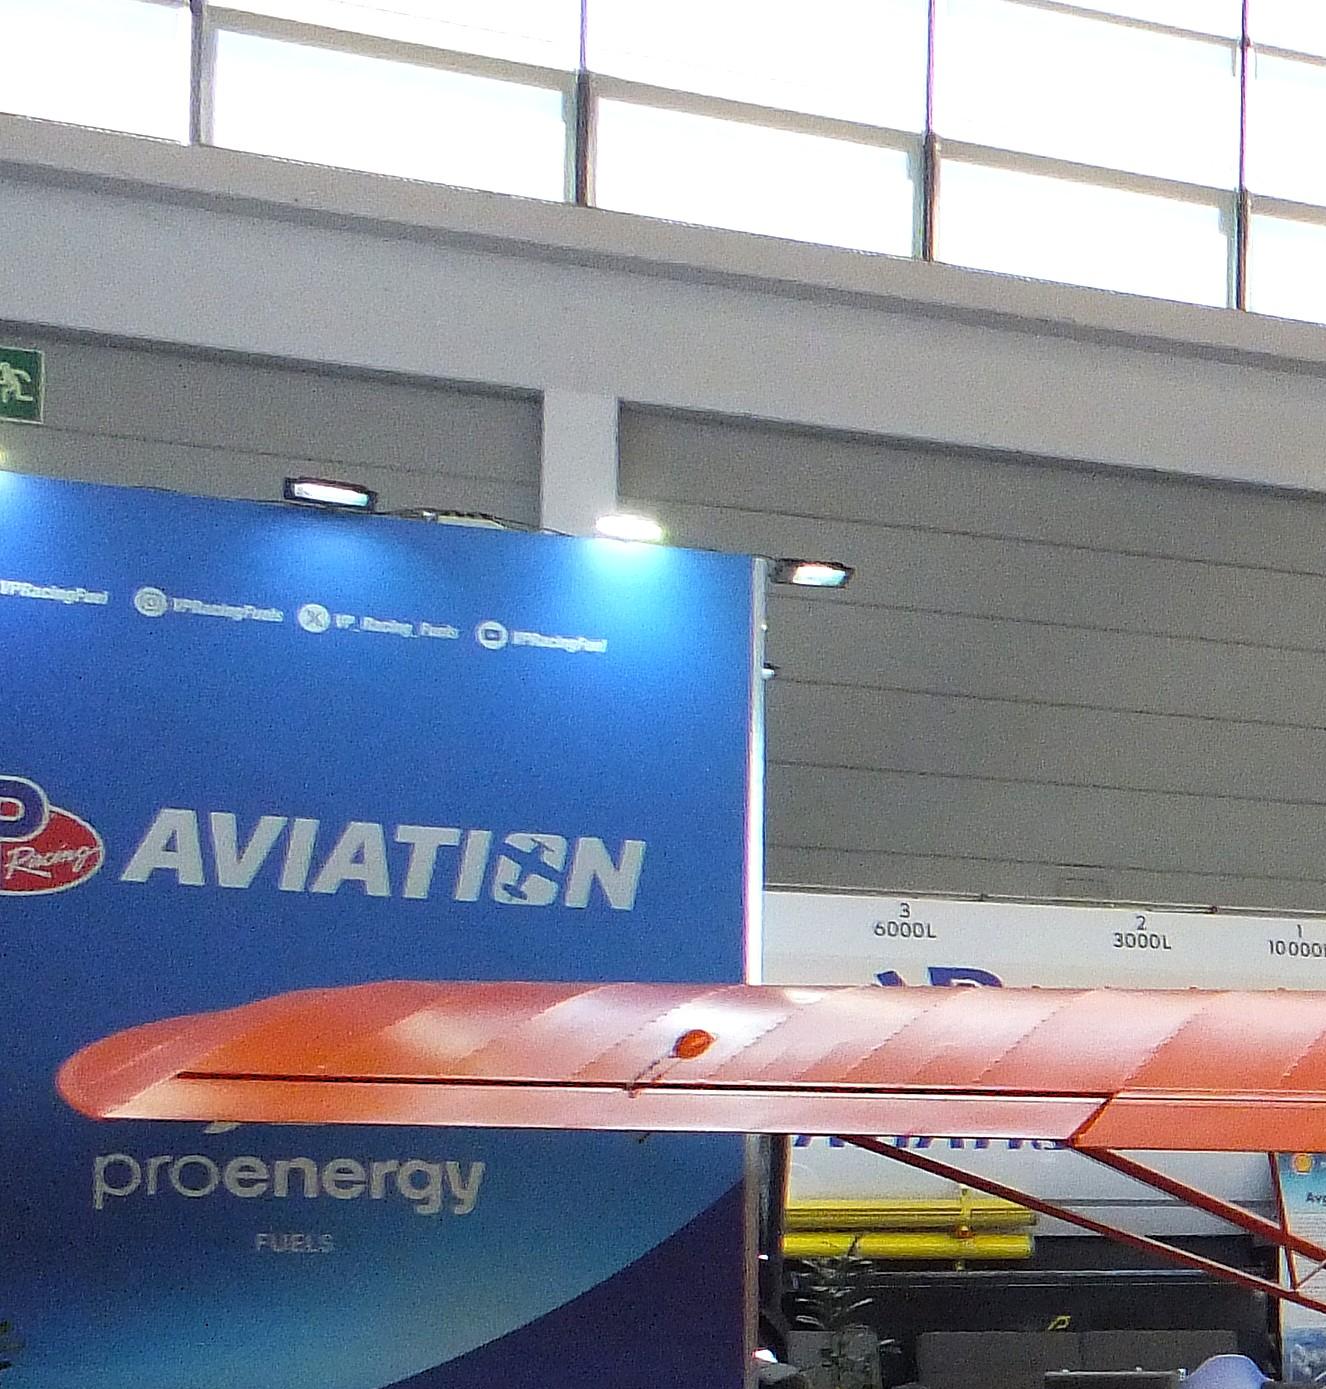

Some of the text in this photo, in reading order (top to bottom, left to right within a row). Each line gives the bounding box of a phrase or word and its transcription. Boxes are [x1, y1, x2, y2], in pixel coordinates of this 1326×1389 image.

[120, 807, 647, 911] AVIATION
[899, 902, 910, 918] 3
[873, 921, 937, 939] 6000L
[1136, 915, 1147, 931] 2
[1297, 924, 1303, 938] 1
[1112, 932, 1172, 950] 3000L
[93, 1152, 487, 1216] proenergy
[256, 1232, 335, 1254] FUELS
